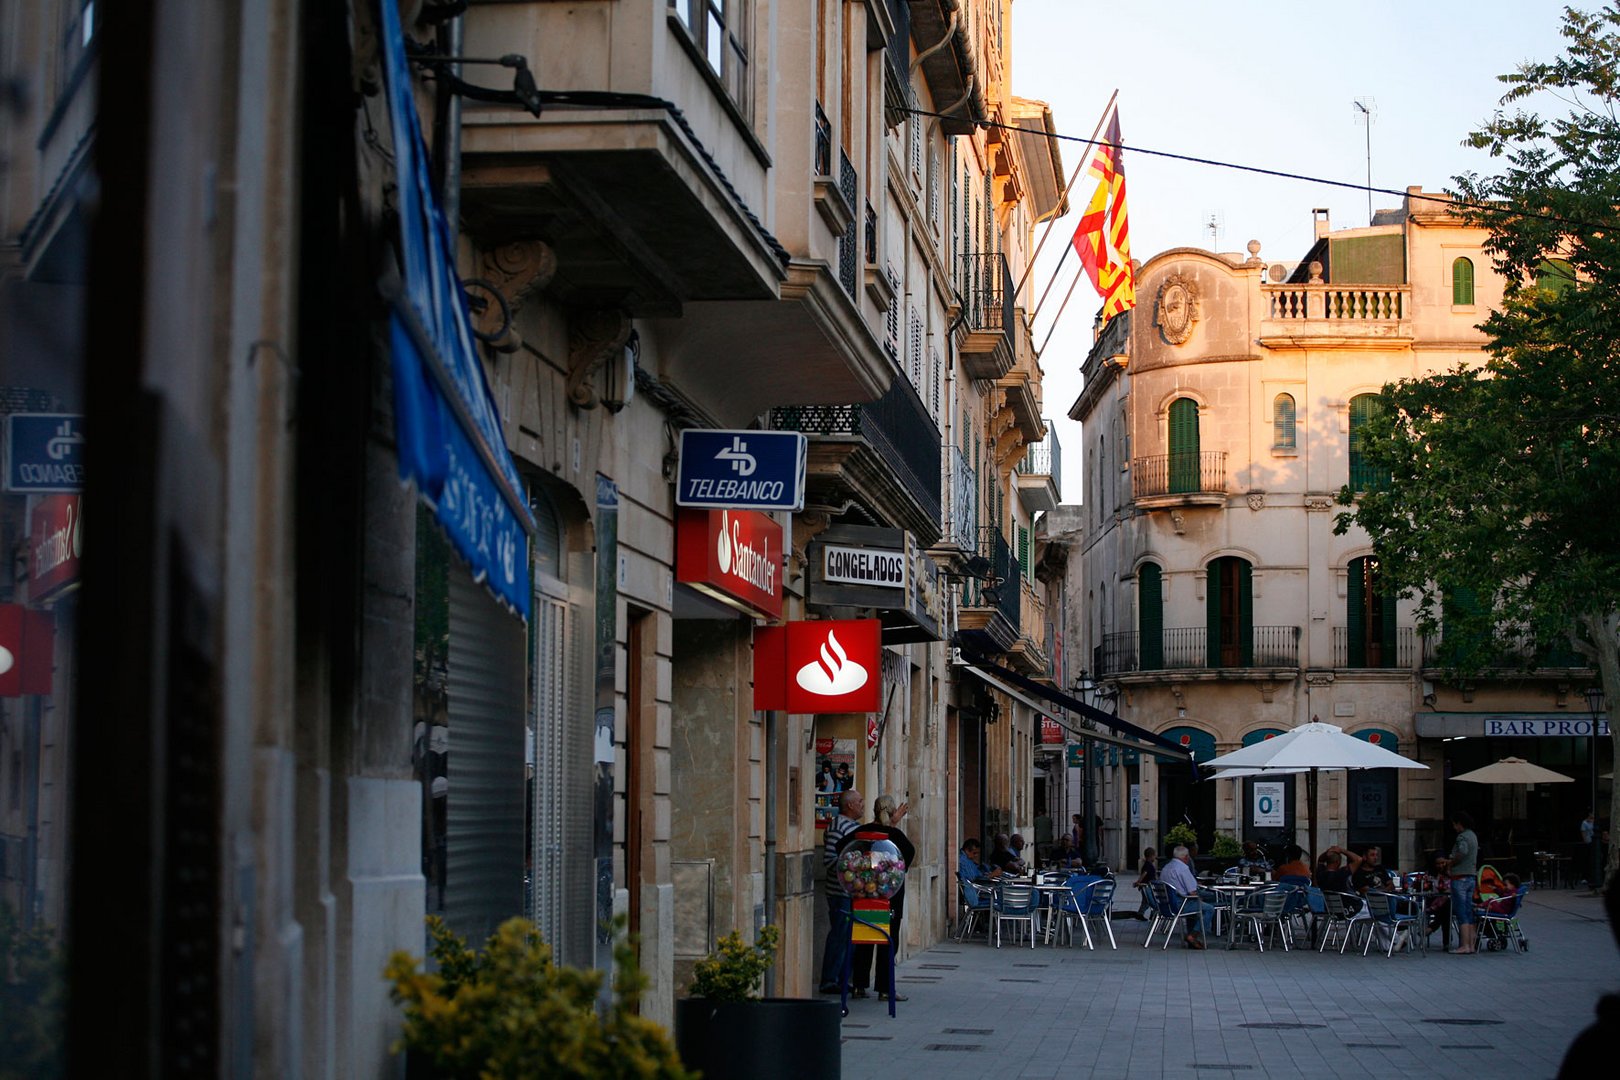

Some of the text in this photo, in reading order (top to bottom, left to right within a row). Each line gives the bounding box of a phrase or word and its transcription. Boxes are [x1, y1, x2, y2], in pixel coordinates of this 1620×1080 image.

[688, 478, 785, 501] TELEBANCO
[731, 519, 776, 597] Santander
[827, 550, 904, 583] CONGELADOS
[1491, 721, 1536, 735] BAR
